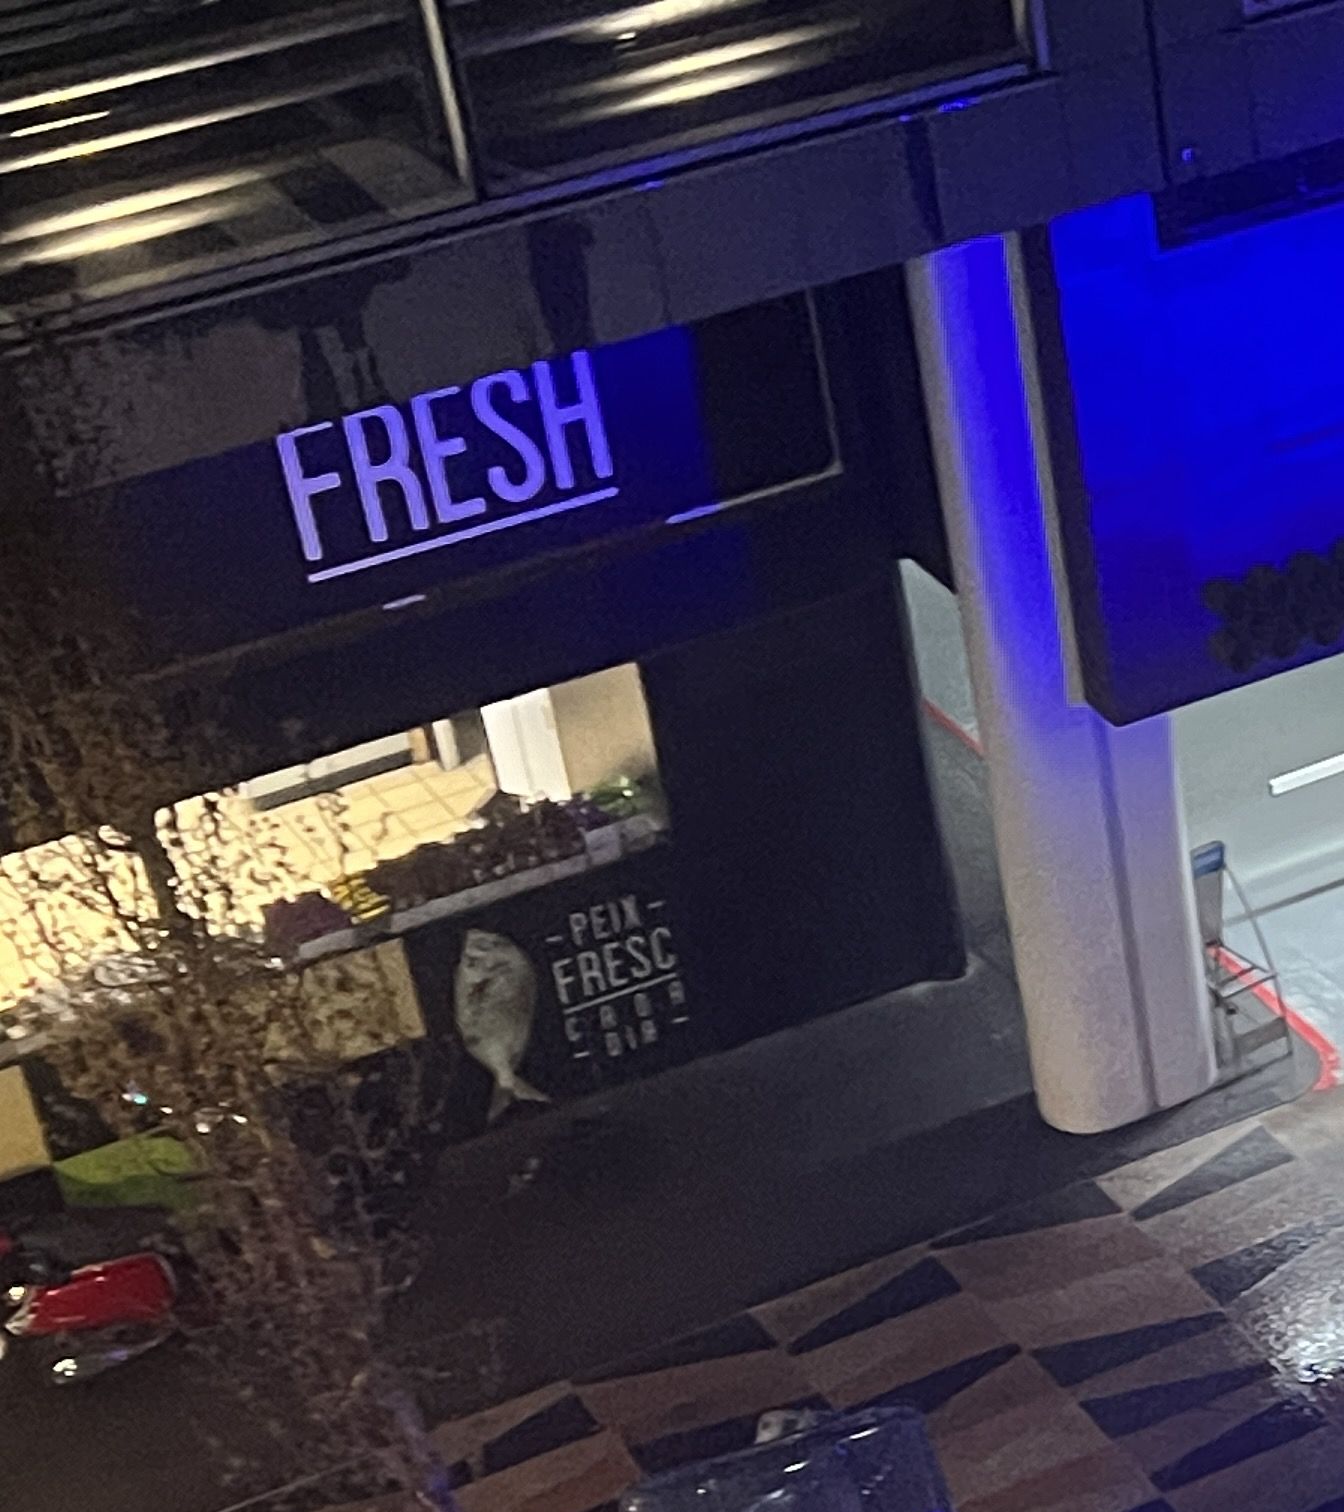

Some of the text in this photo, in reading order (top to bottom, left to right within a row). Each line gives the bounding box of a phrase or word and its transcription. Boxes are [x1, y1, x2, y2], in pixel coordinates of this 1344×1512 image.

[276, 349, 614, 561] FRESH
[568, 894, 643, 947] PEIX
[551, 926, 678, 1005] FRESC
